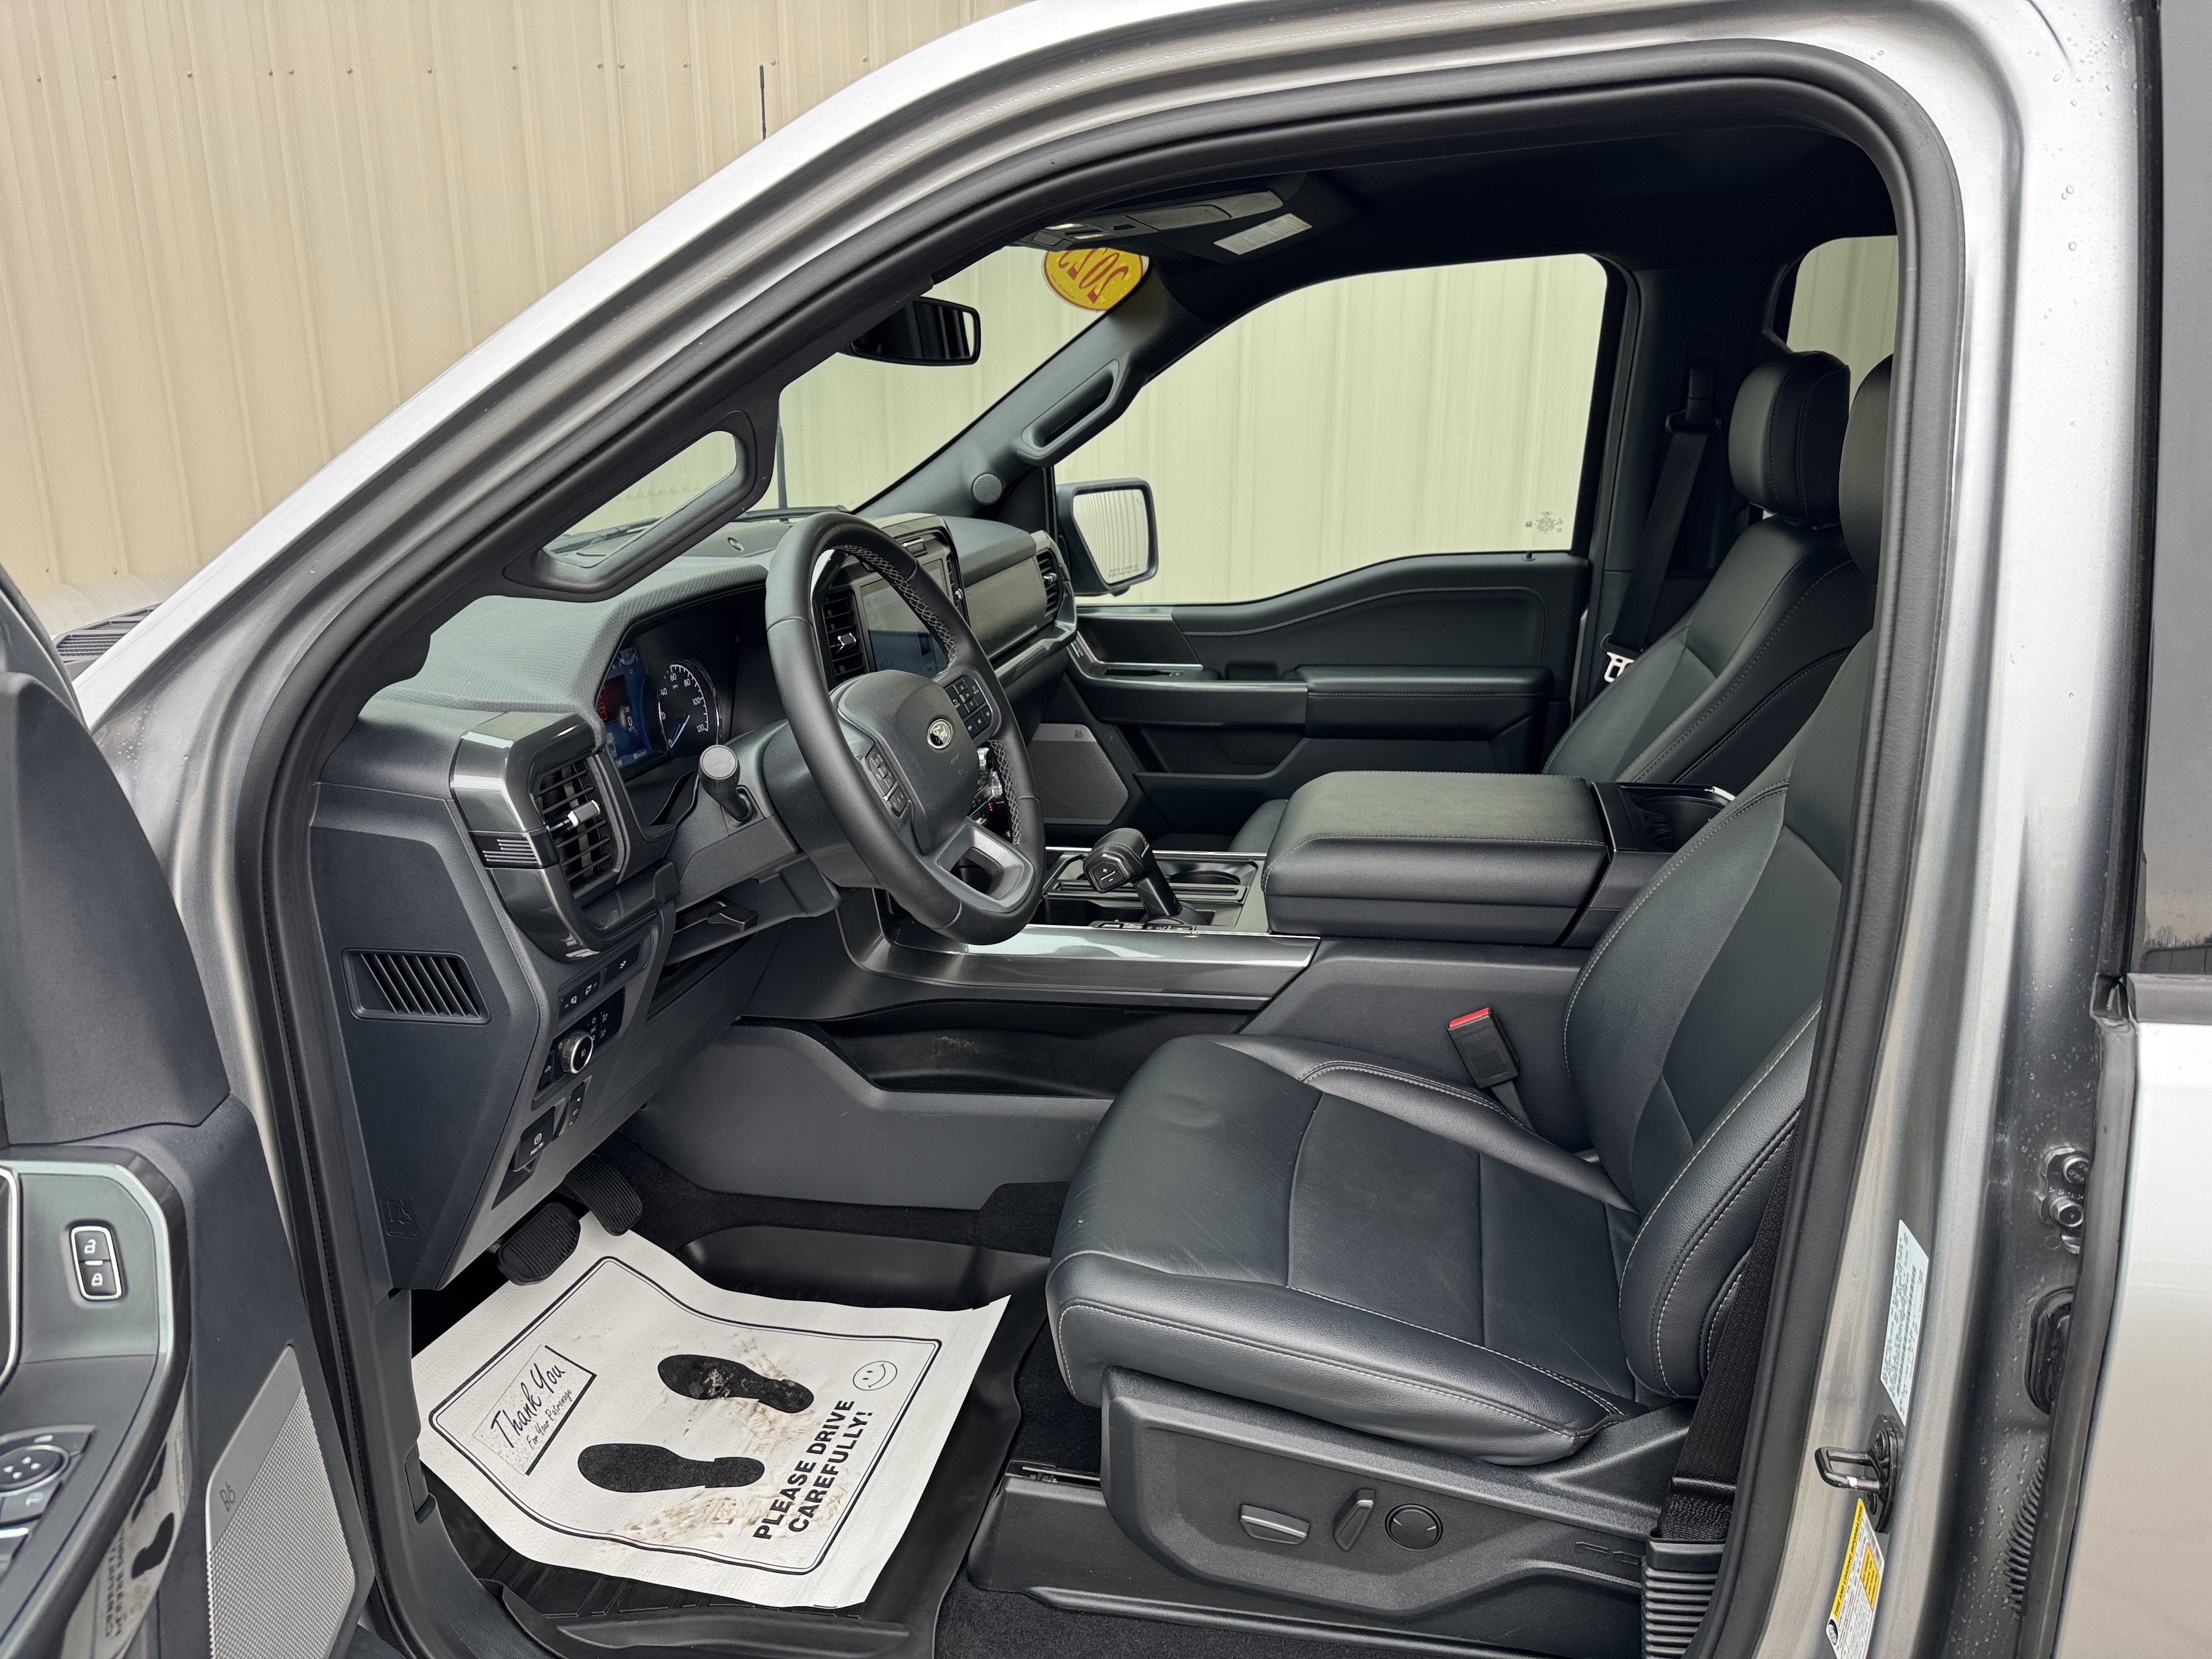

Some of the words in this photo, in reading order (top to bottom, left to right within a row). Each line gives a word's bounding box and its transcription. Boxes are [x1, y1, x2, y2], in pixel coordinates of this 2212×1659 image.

[670, 673, 677, 681] 60
[684, 679, 691, 687] 80
[692, 697, 701, 706] 100
[628, 716, 633, 726] 0
[696, 724, 705, 733] 120
[490, 1382, 542, 1448] Thank
[530, 1362, 566, 1394] You
[526, 1434, 538, 1449] For
[535, 1422, 550, 1436] Your
[545, 1389, 573, 1421] Patronage
[752, 1460, 817, 1540] PLEASE
[805, 1400, 855, 1455] DRIVE
[788, 1412, 873, 1532] CAREFULLY!
[1843, 1554, 1852, 1585] LOADING
